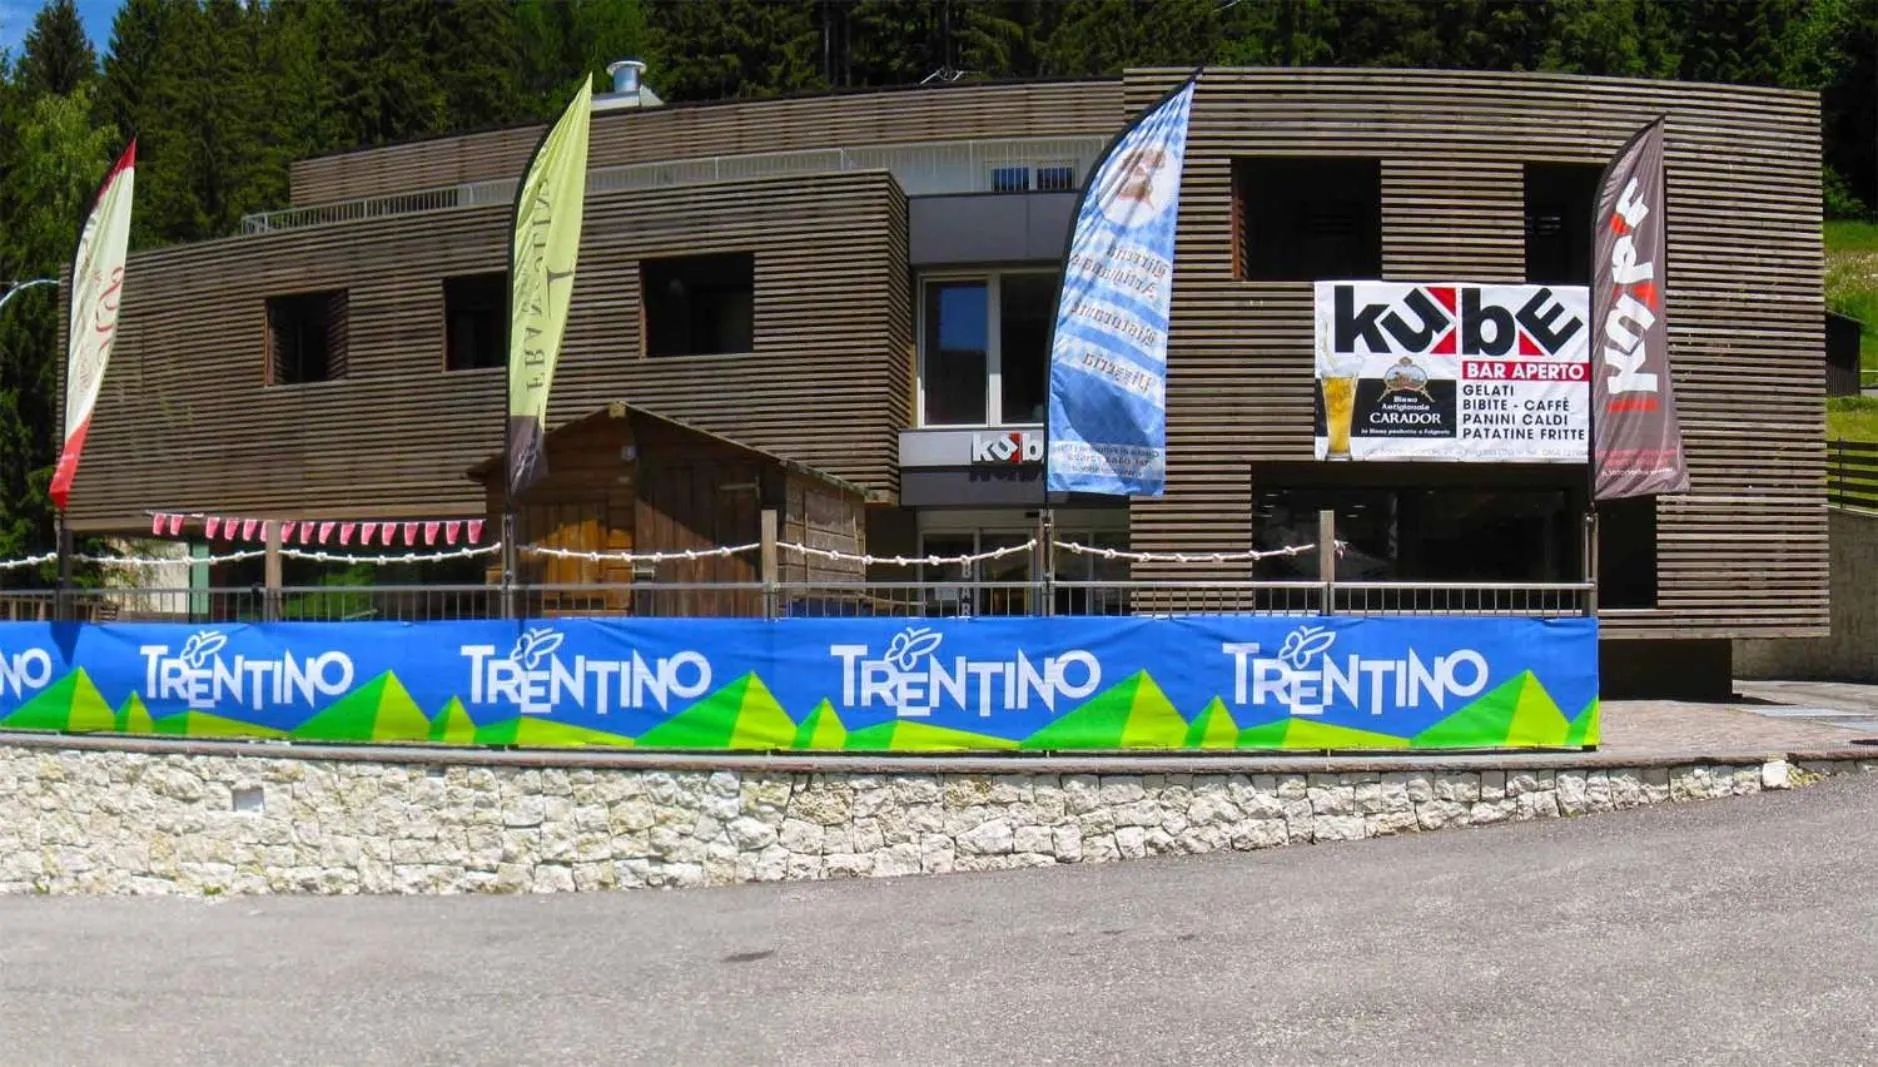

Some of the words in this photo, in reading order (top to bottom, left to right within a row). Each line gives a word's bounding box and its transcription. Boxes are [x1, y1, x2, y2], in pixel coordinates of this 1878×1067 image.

[1467, 362, 1506, 378] BAR
[1511, 364, 1584, 379] APERTO
[1463, 384, 1514, 396] GELATI
[1463, 399, 1507, 410] BIBITE
[1524, 397, 1570, 411] CAFFÈ
[1370, 412, 1441, 423] CARADOR
[1463, 413, 1515, 425] PANINI
[1522, 414, 1568, 425] CALDI
[1463, 428, 1534, 439] PATATINE
[1540, 429, 1584, 440] FRITTE
[140, 645, 354, 710] TRENTINO
[460, 645, 712, 714] TRENTINO
[829, 644, 1101, 717] TRENTINO
[1222, 642, 1489, 716] TRENTINO
